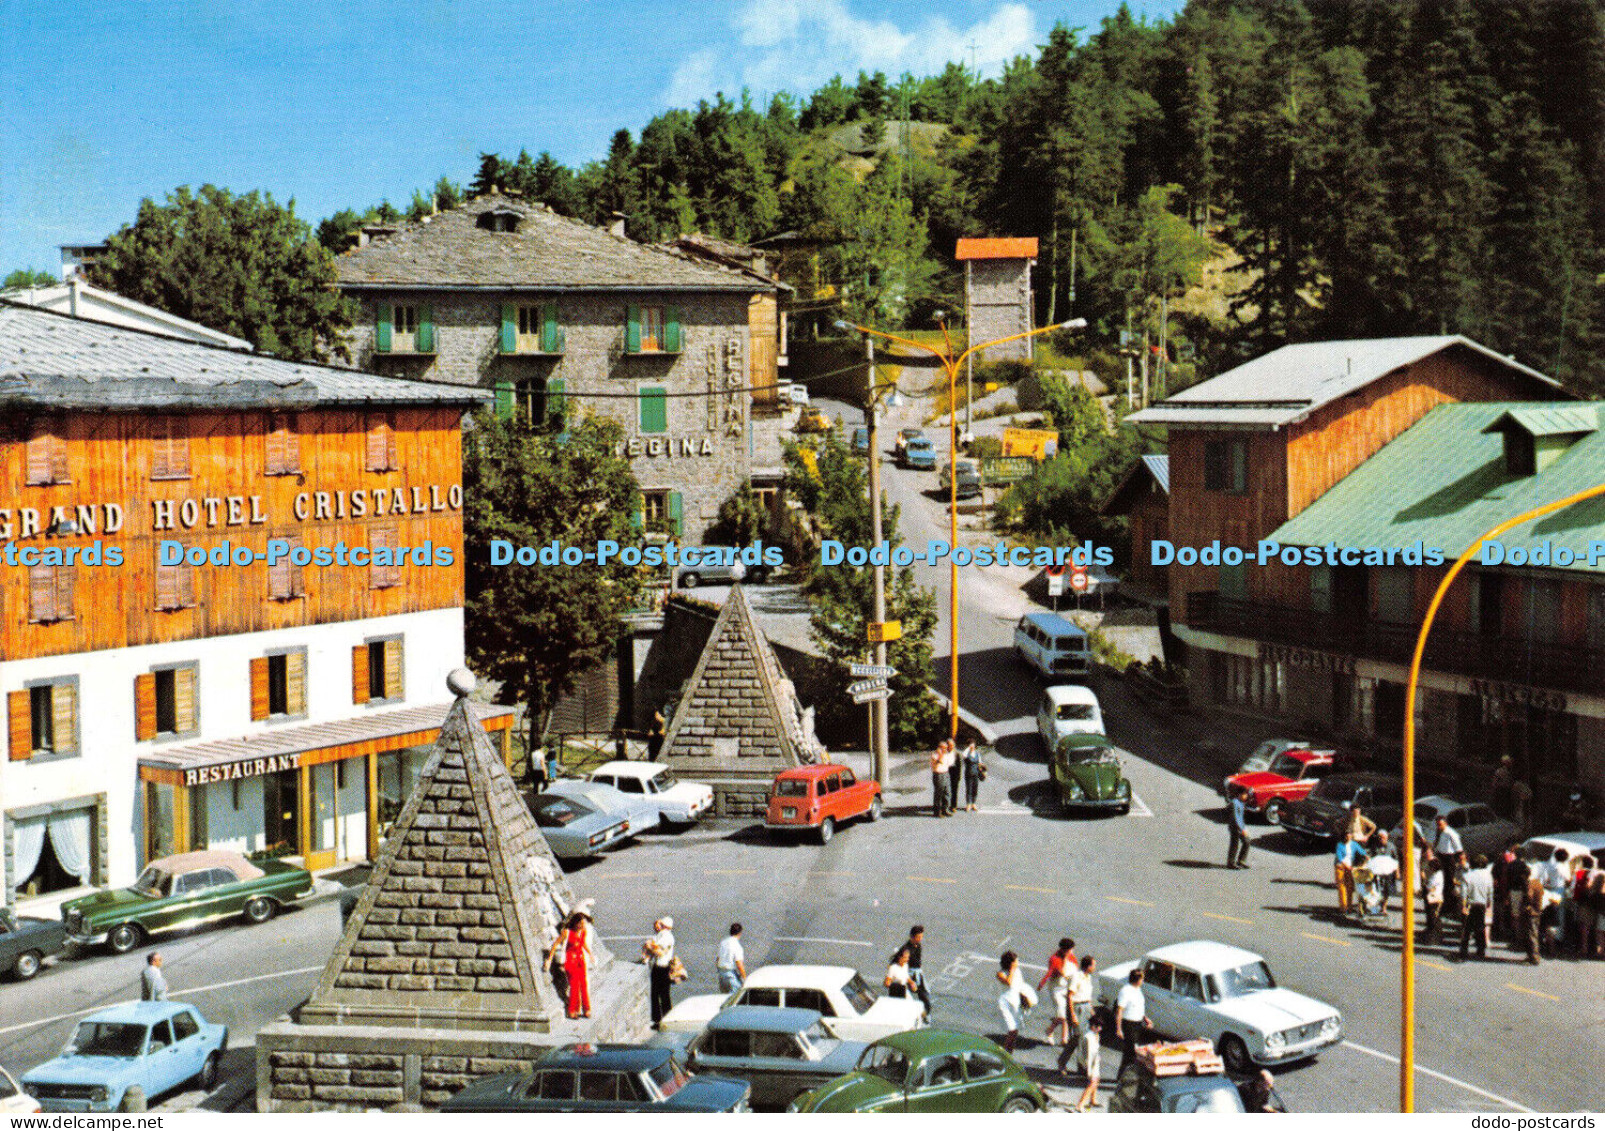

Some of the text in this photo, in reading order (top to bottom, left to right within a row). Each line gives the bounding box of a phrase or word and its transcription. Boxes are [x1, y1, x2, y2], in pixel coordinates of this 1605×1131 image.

[0, 483, 464, 539] GRAND HOTEL CRISTALLO
[185, 752, 301, 787] RESTAURANT
